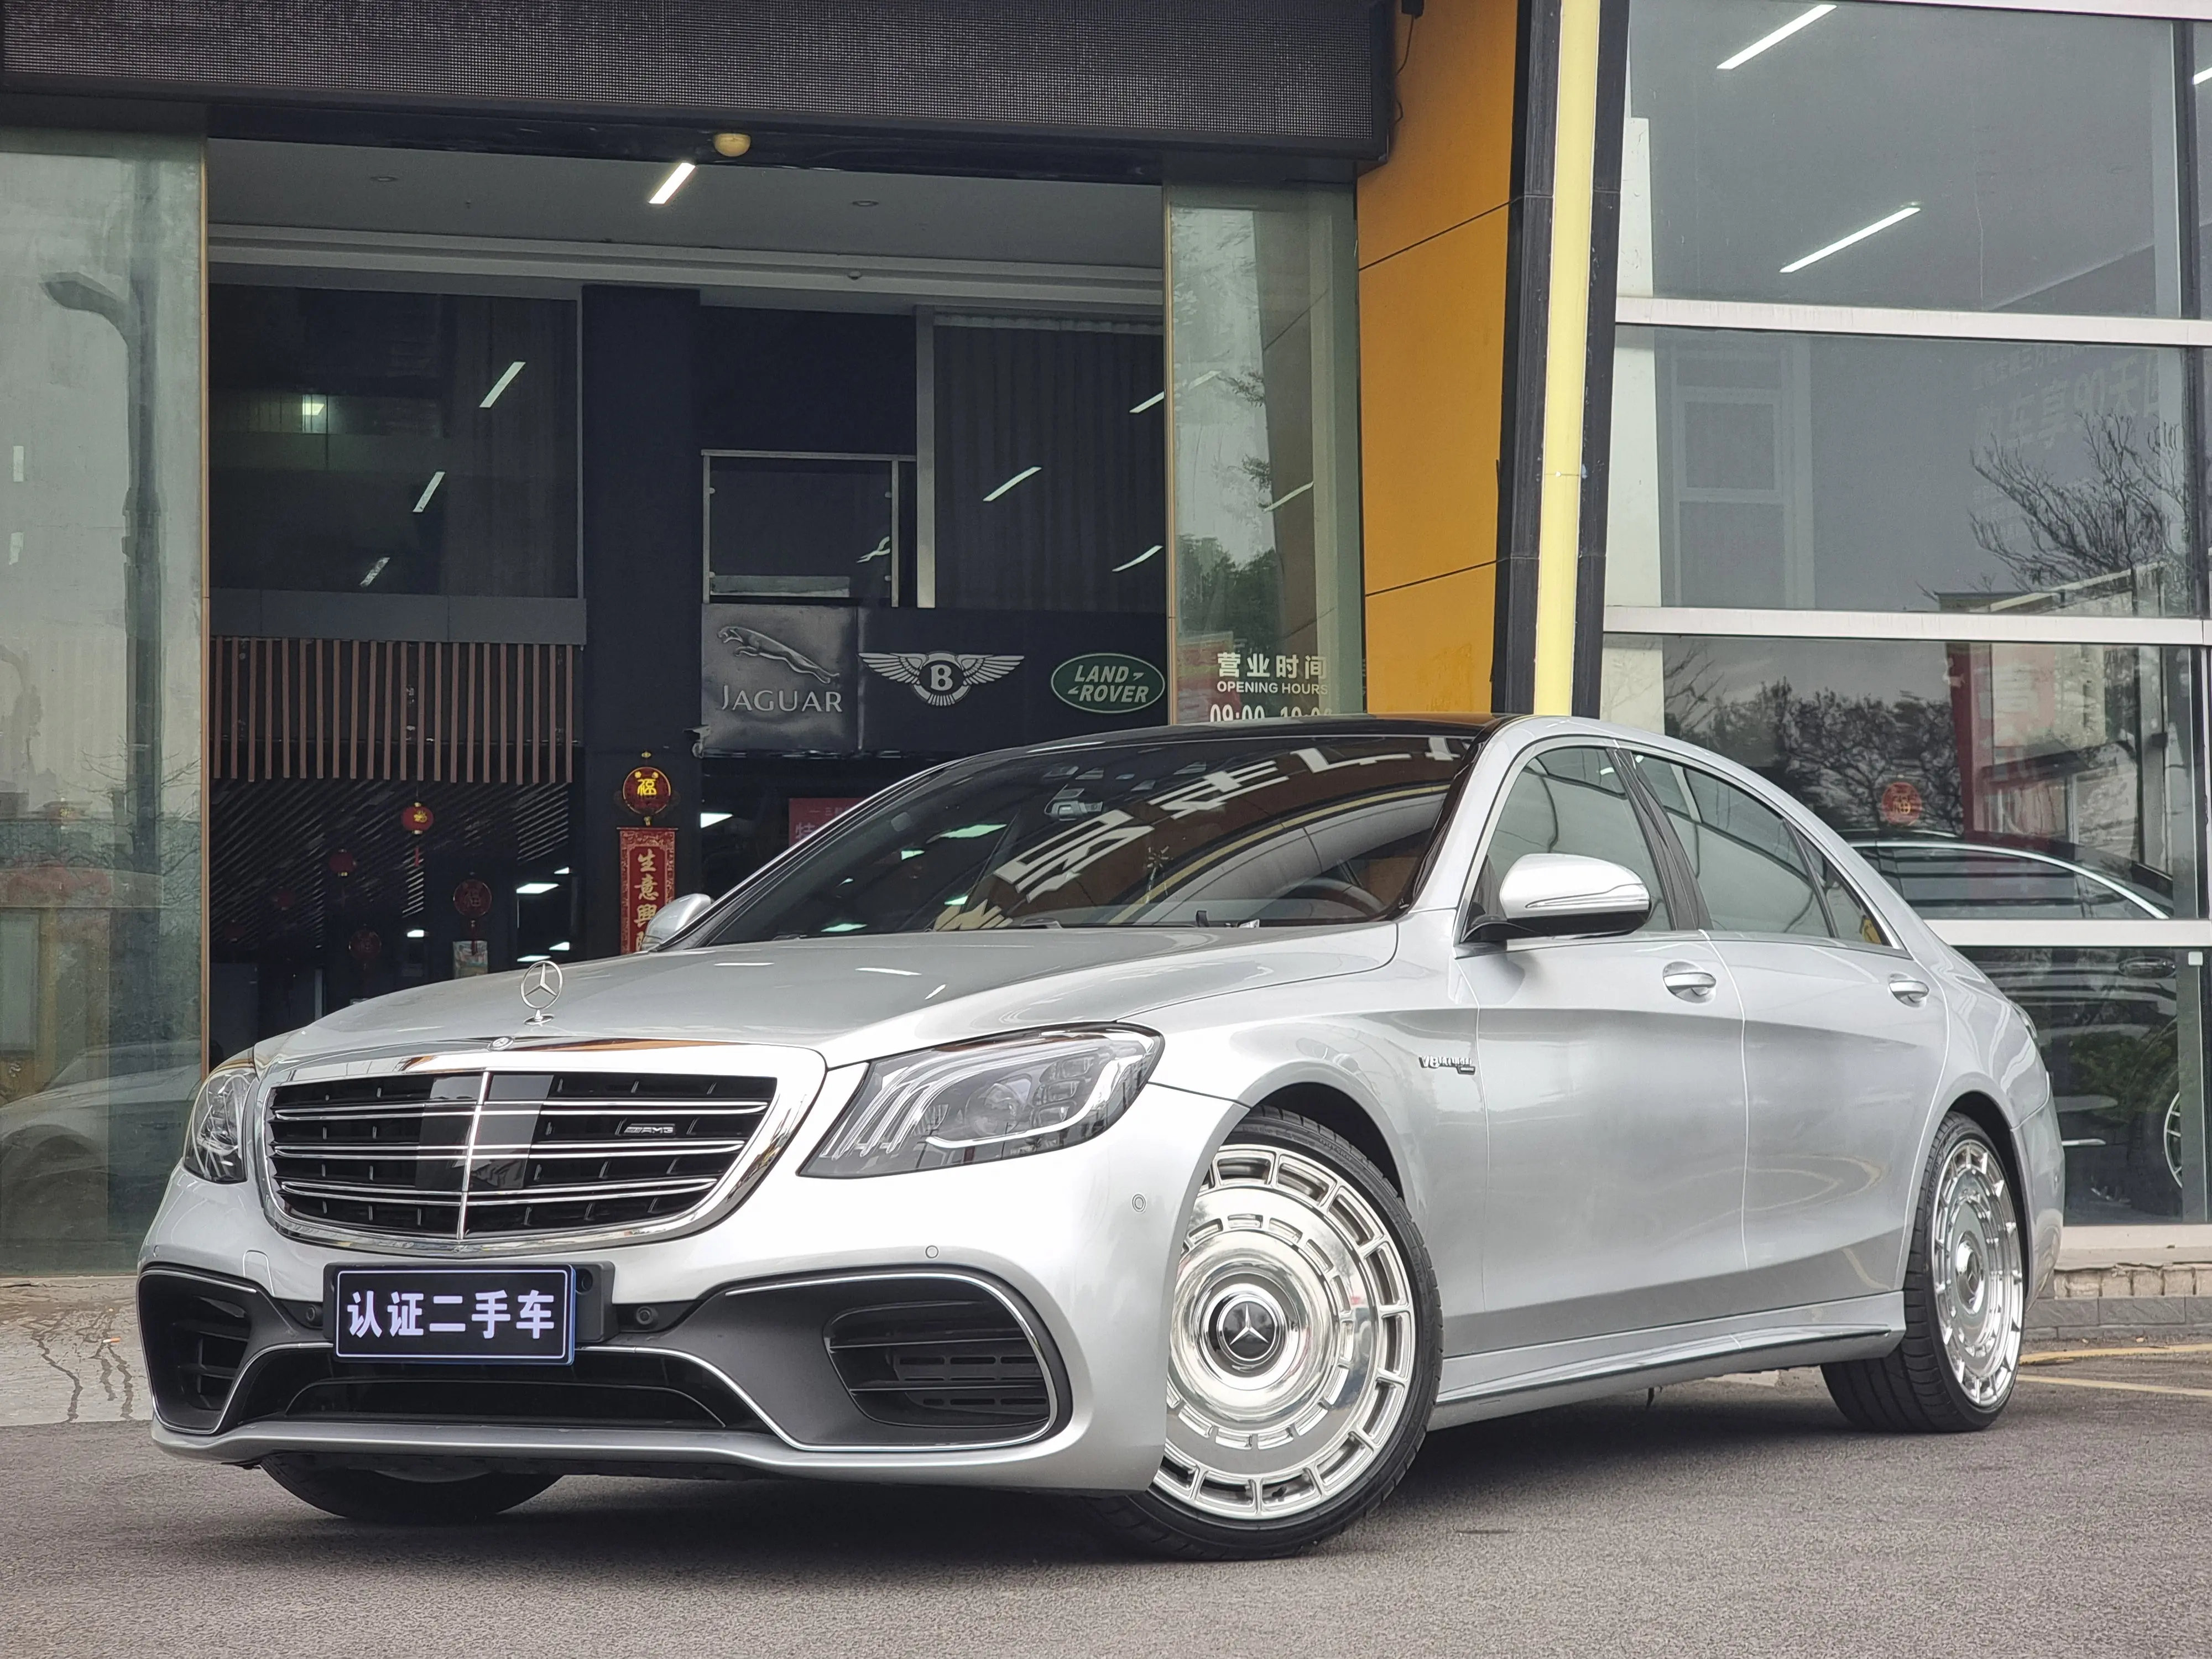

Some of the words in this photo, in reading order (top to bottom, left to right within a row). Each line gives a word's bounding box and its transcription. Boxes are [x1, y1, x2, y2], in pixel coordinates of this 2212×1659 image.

[1074, 664, 1129, 683] LAND
[1217, 651, 1327, 680] 营业时间
[930, 664, 954, 691] B
[1217, 681, 1279, 693] OPENING
[1281, 683, 1328, 695] HOURS
[721, 685, 843, 713] JAGUAR
[1079, 685, 1150, 703] ROVER
[637, 778, 657, 796] 福
[347, 1290, 555, 1339] 认证二手车
